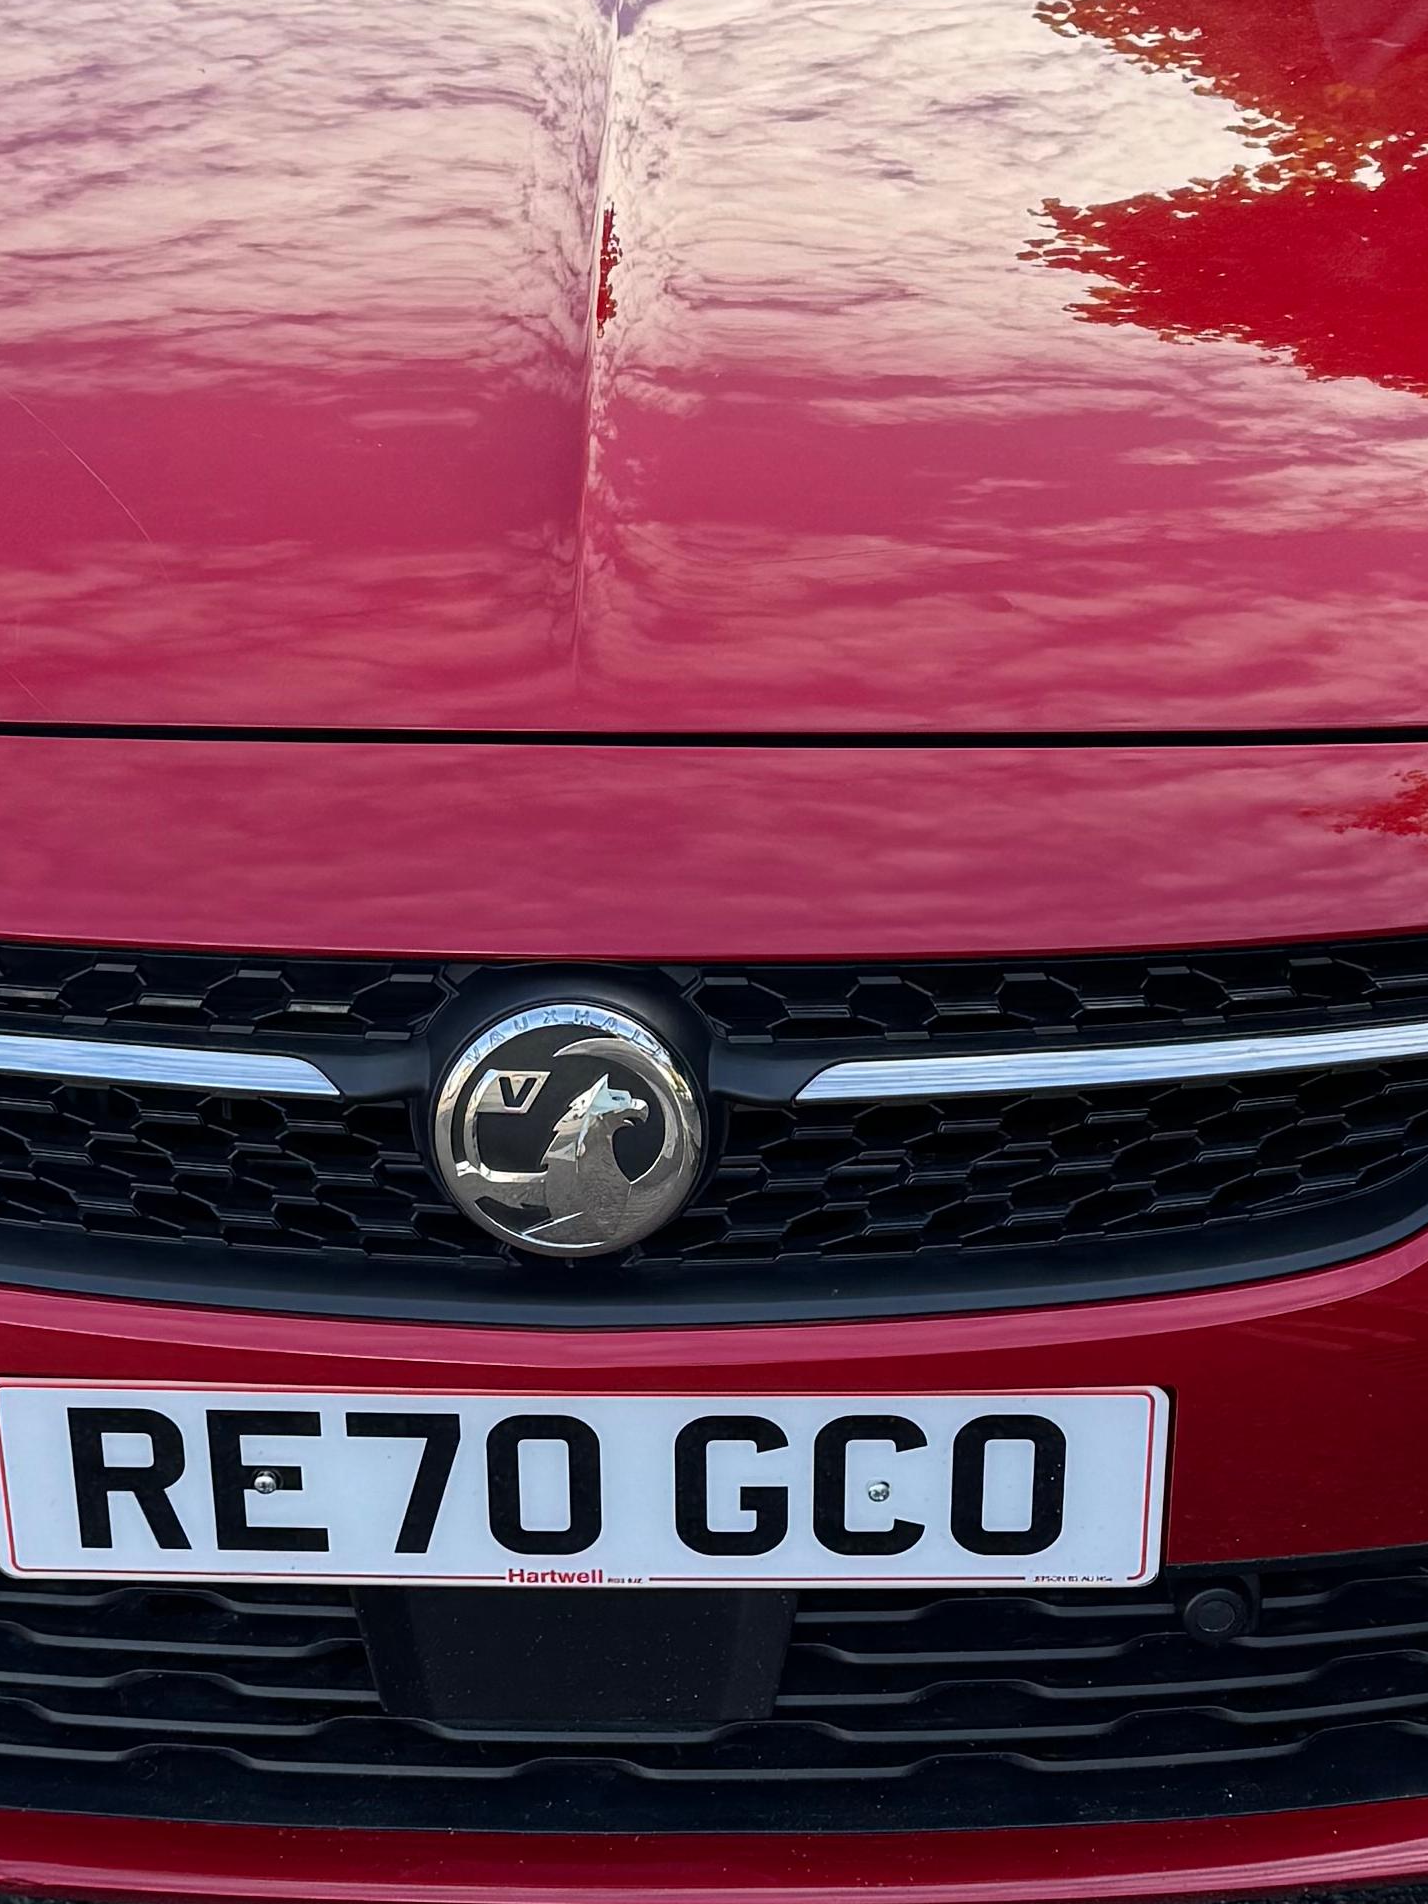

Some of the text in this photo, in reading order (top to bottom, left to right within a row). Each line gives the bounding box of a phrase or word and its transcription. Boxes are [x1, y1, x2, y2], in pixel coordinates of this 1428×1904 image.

[67, 1407, 1069, 1557] RE70 GCO
[508, 1568, 604, 1584] Hartwell
